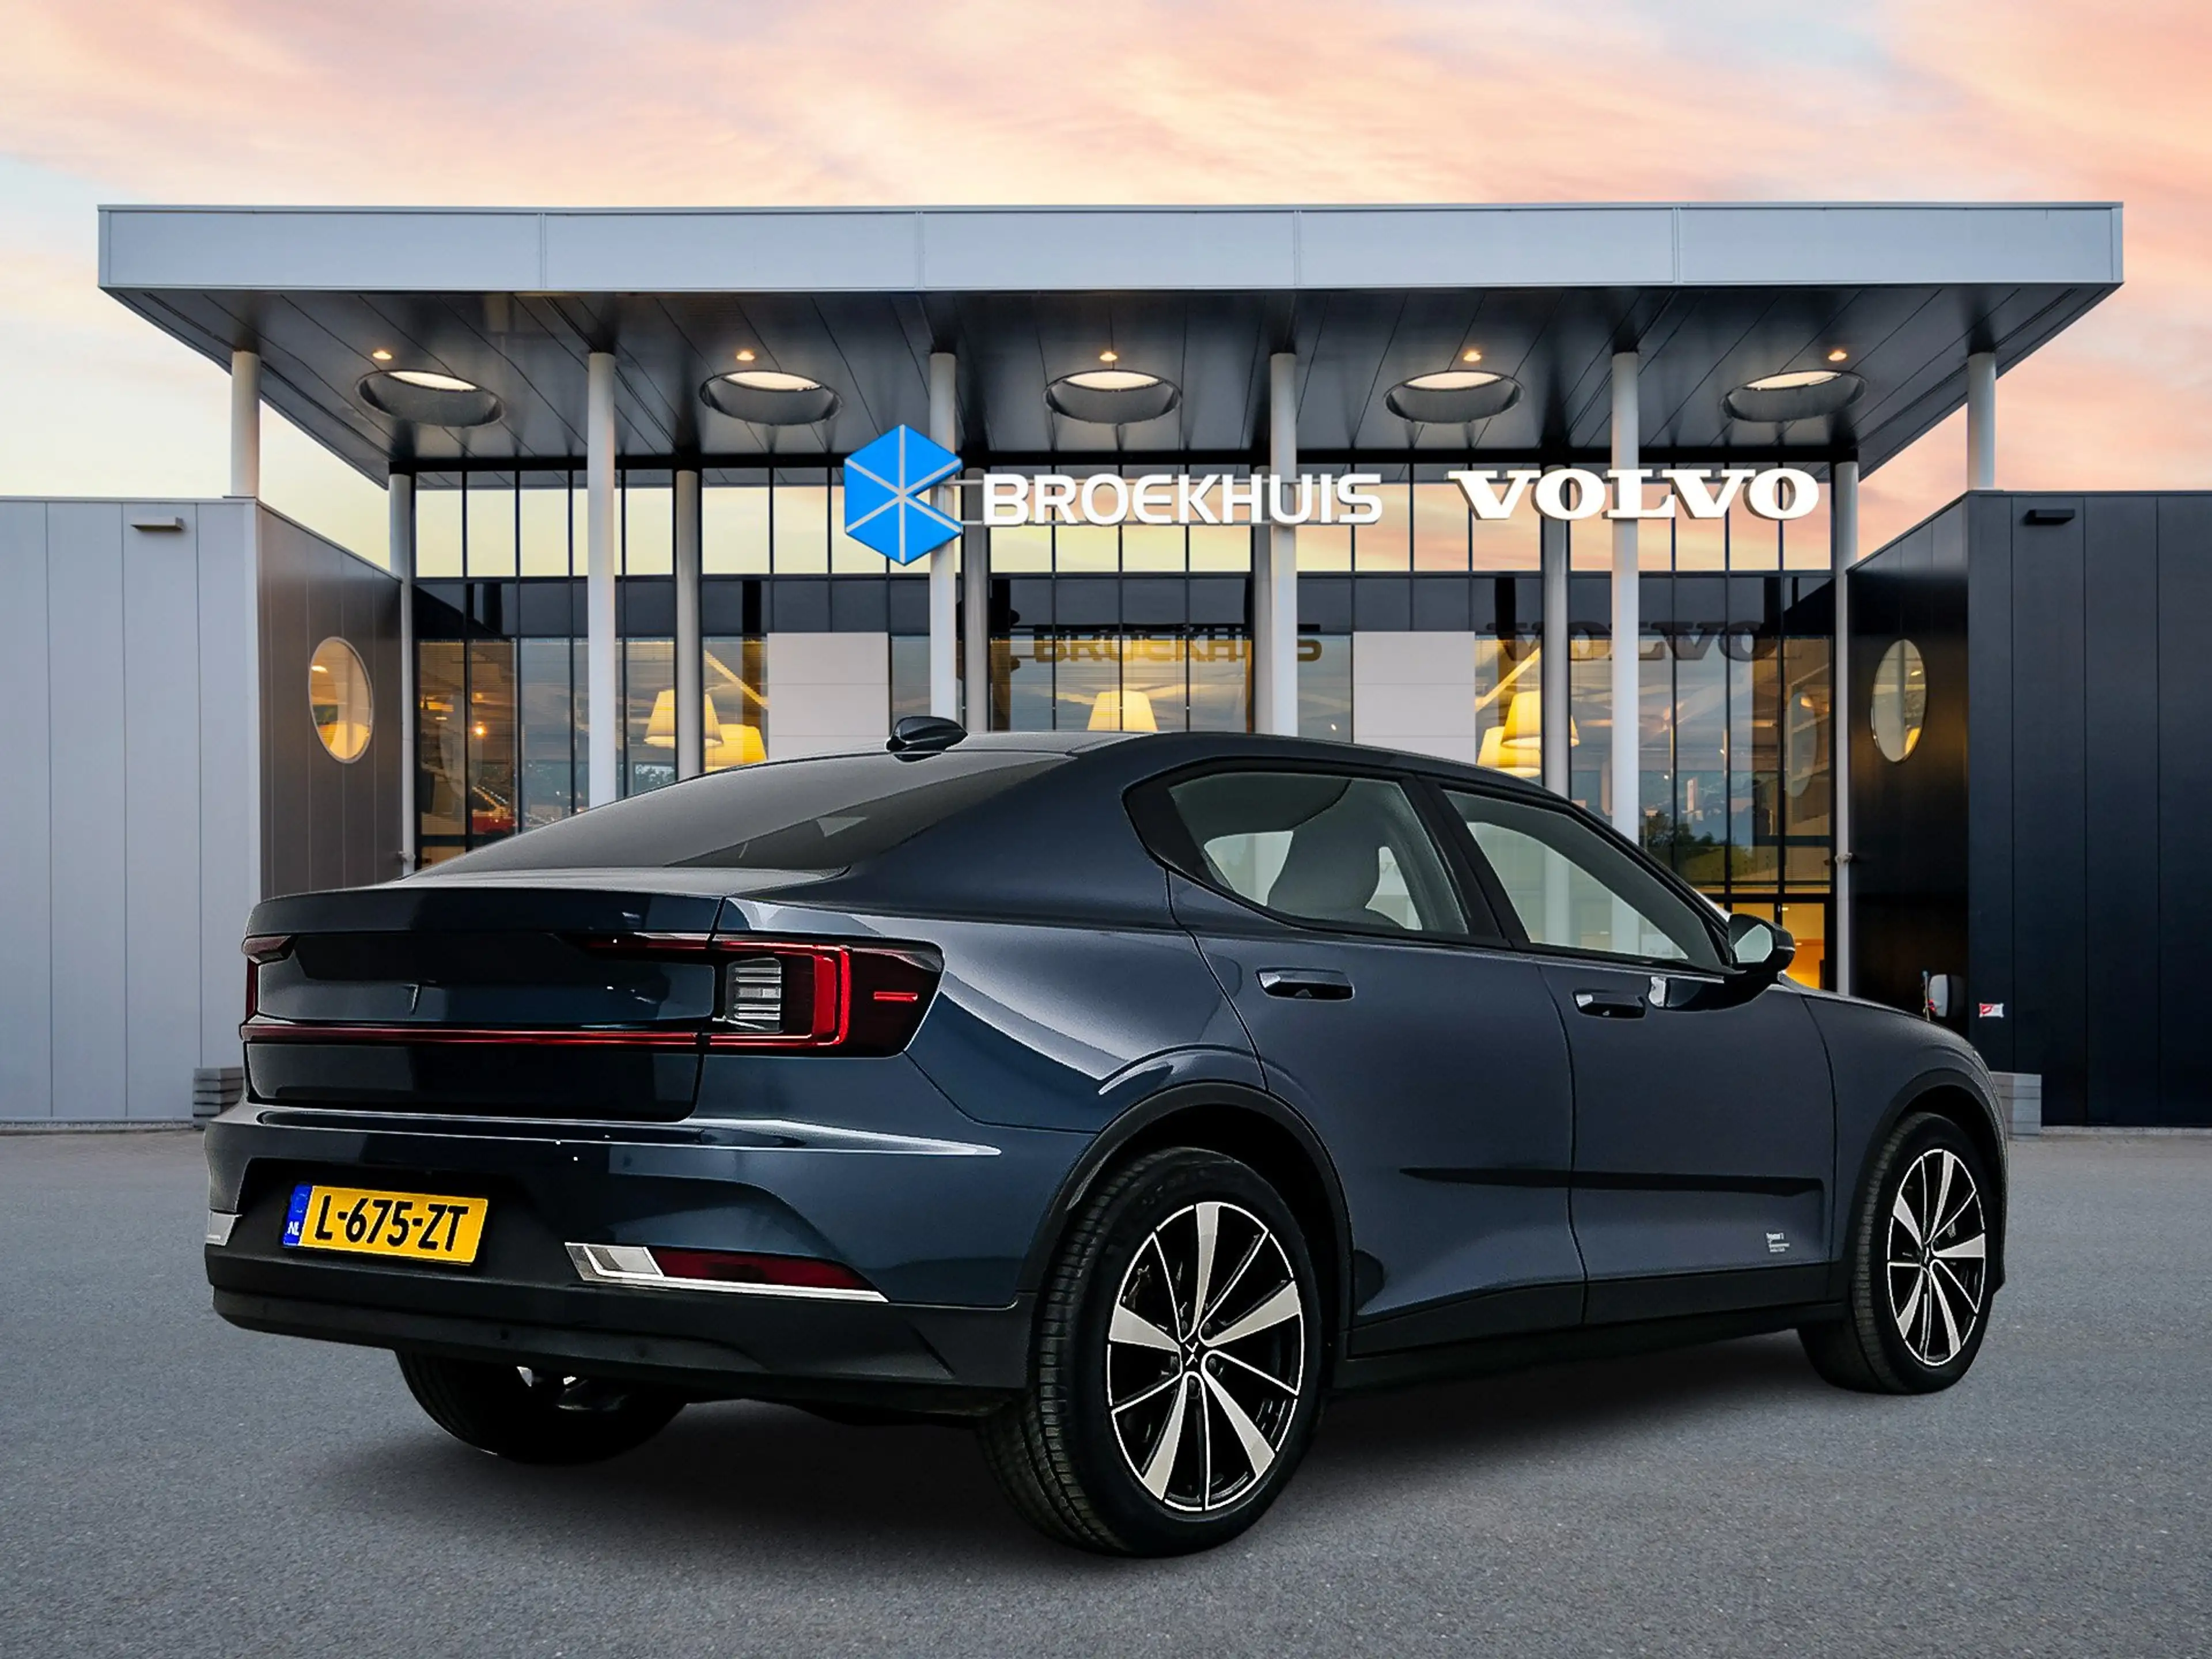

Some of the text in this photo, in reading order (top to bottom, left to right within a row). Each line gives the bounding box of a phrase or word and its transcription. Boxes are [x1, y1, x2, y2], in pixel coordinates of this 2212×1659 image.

[983, 473, 1382, 525] BROEKHUIS
[1445, 468, 1820, 520] VOLVO
[1034, 624, 1323, 663] BROEKHS
[287, 1221, 300, 1236] NL
[315, 1195, 469, 1252] L-675-ZT
